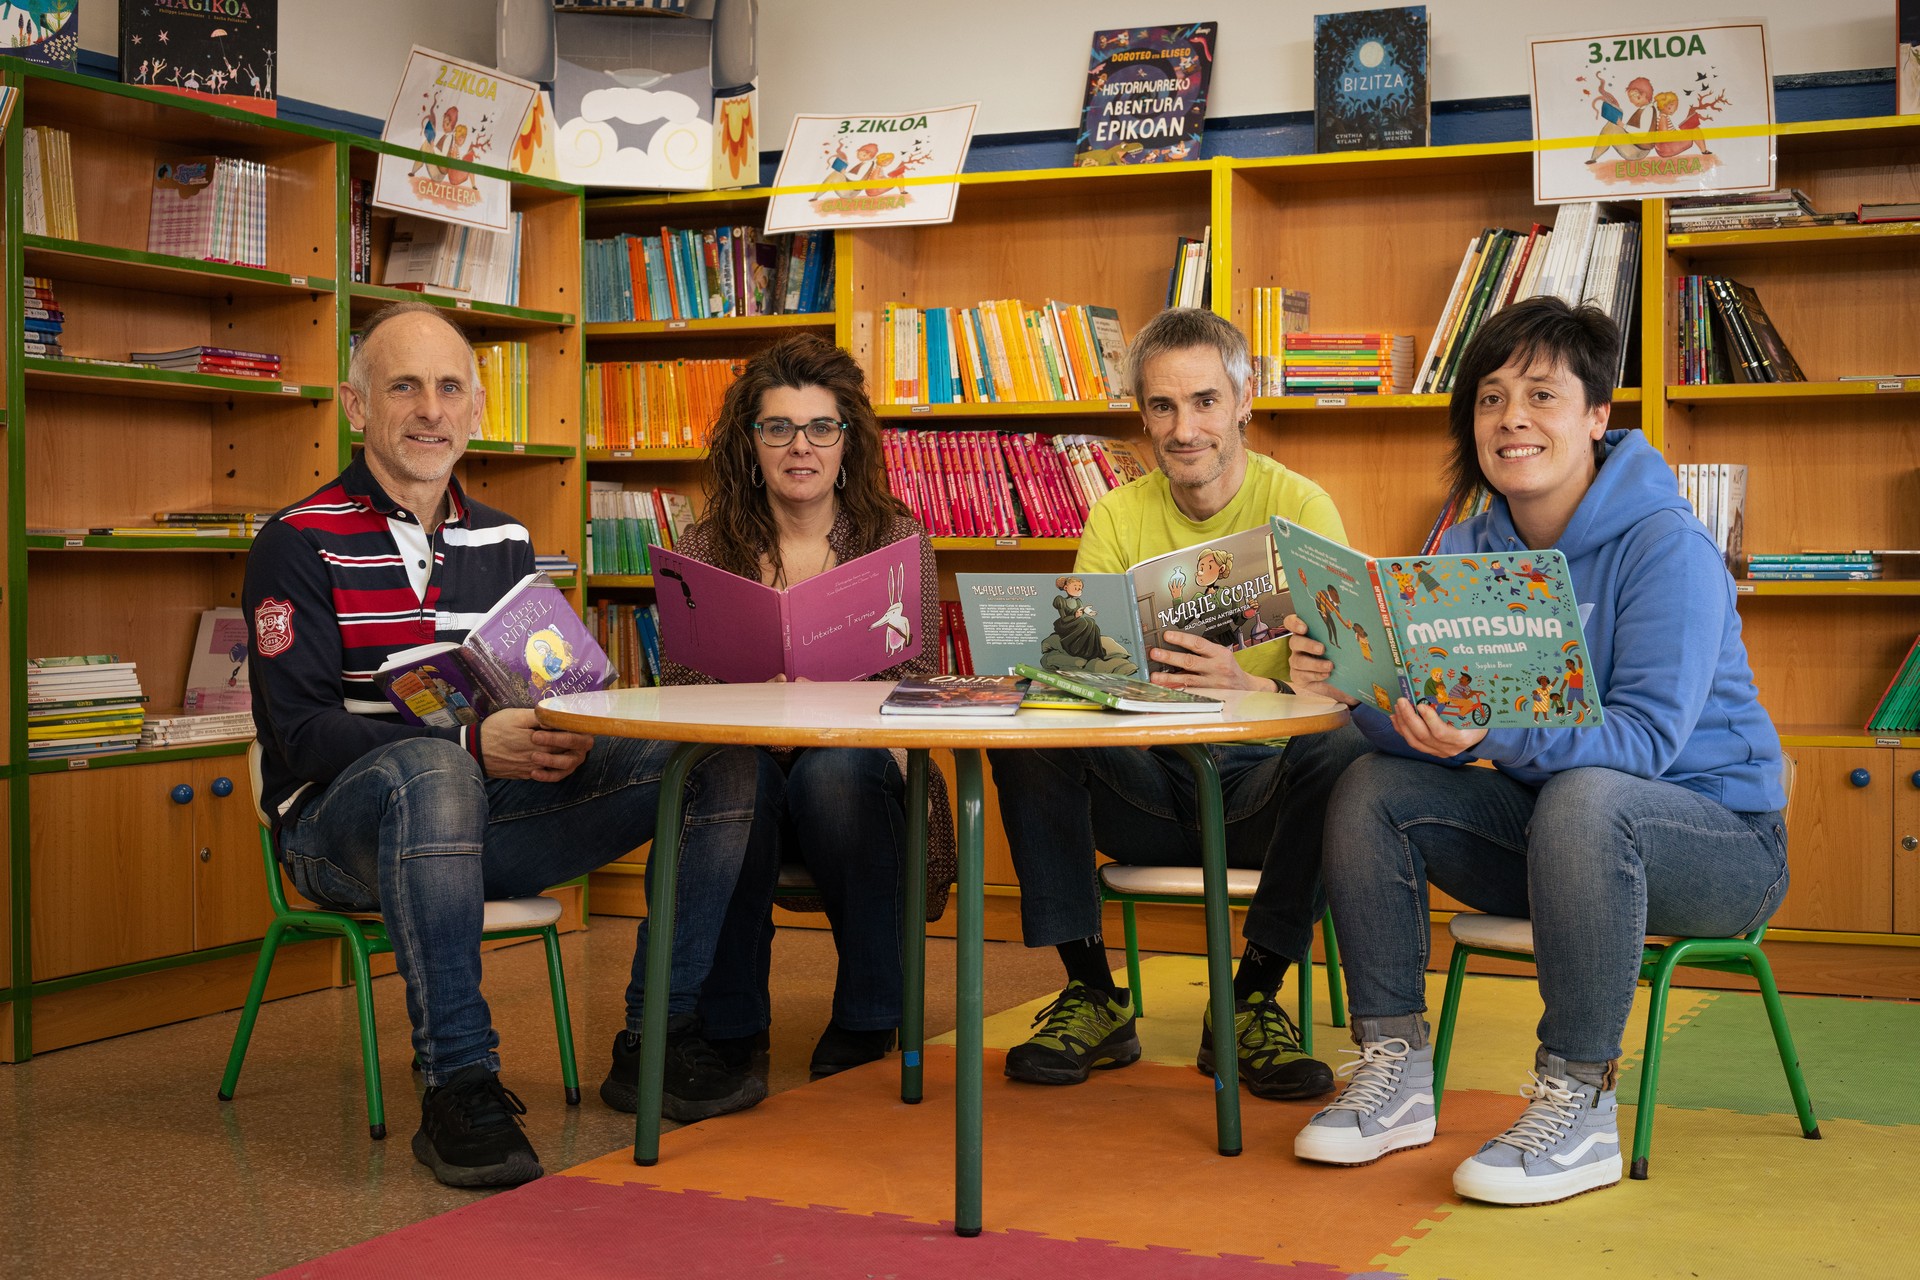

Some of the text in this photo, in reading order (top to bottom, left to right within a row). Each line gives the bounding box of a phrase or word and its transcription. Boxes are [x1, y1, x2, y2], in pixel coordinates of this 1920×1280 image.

[1112, 51, 1152, 62] DOROTEO
[1161, 48, 1191, 58] ELISEO
[1588, 34, 1706, 63] 3.ZIKLOA
[435, 65, 498, 101] 2.ZIKLOA
[1102, 78, 1190, 96] HISTORIAURREKO
[1344, 74, 1404, 92] BIZITZA
[1103, 97, 1184, 116] ABENTURA
[838, 116, 928, 134] 3.ZIKLOA
[1096, 117, 1185, 141] EPIKOAN
[1615, 158, 1703, 178] EUSKARA
[418, 180, 476, 204] GAZTELERA
[821, 197, 906, 212] GAZTELERA
[1026, 480, 1036, 498] SECRETA
[1033, 498, 1041, 513] CIUDAD
[972, 585, 1037, 596] MARIE CURIE
[1158, 574, 1273, 628] MARIE CURIE
[500, 600, 553, 650] RIDDELL
[501, 599, 534, 629] Chris
[1184, 605, 1251, 631] RADIOAREN AKTIBITATEA
[802, 610, 875, 646] Untxitxo Txuria
[1374, 585, 1401, 666] MAITASUNA ETA FAMILIA
[1406, 616, 1563, 646] MAITASUNA
[1453, 642, 1528, 655] eta FAMILIA
[1475, 662, 1495, 671] Sophie
[544, 660, 593, 700] Ottoline
